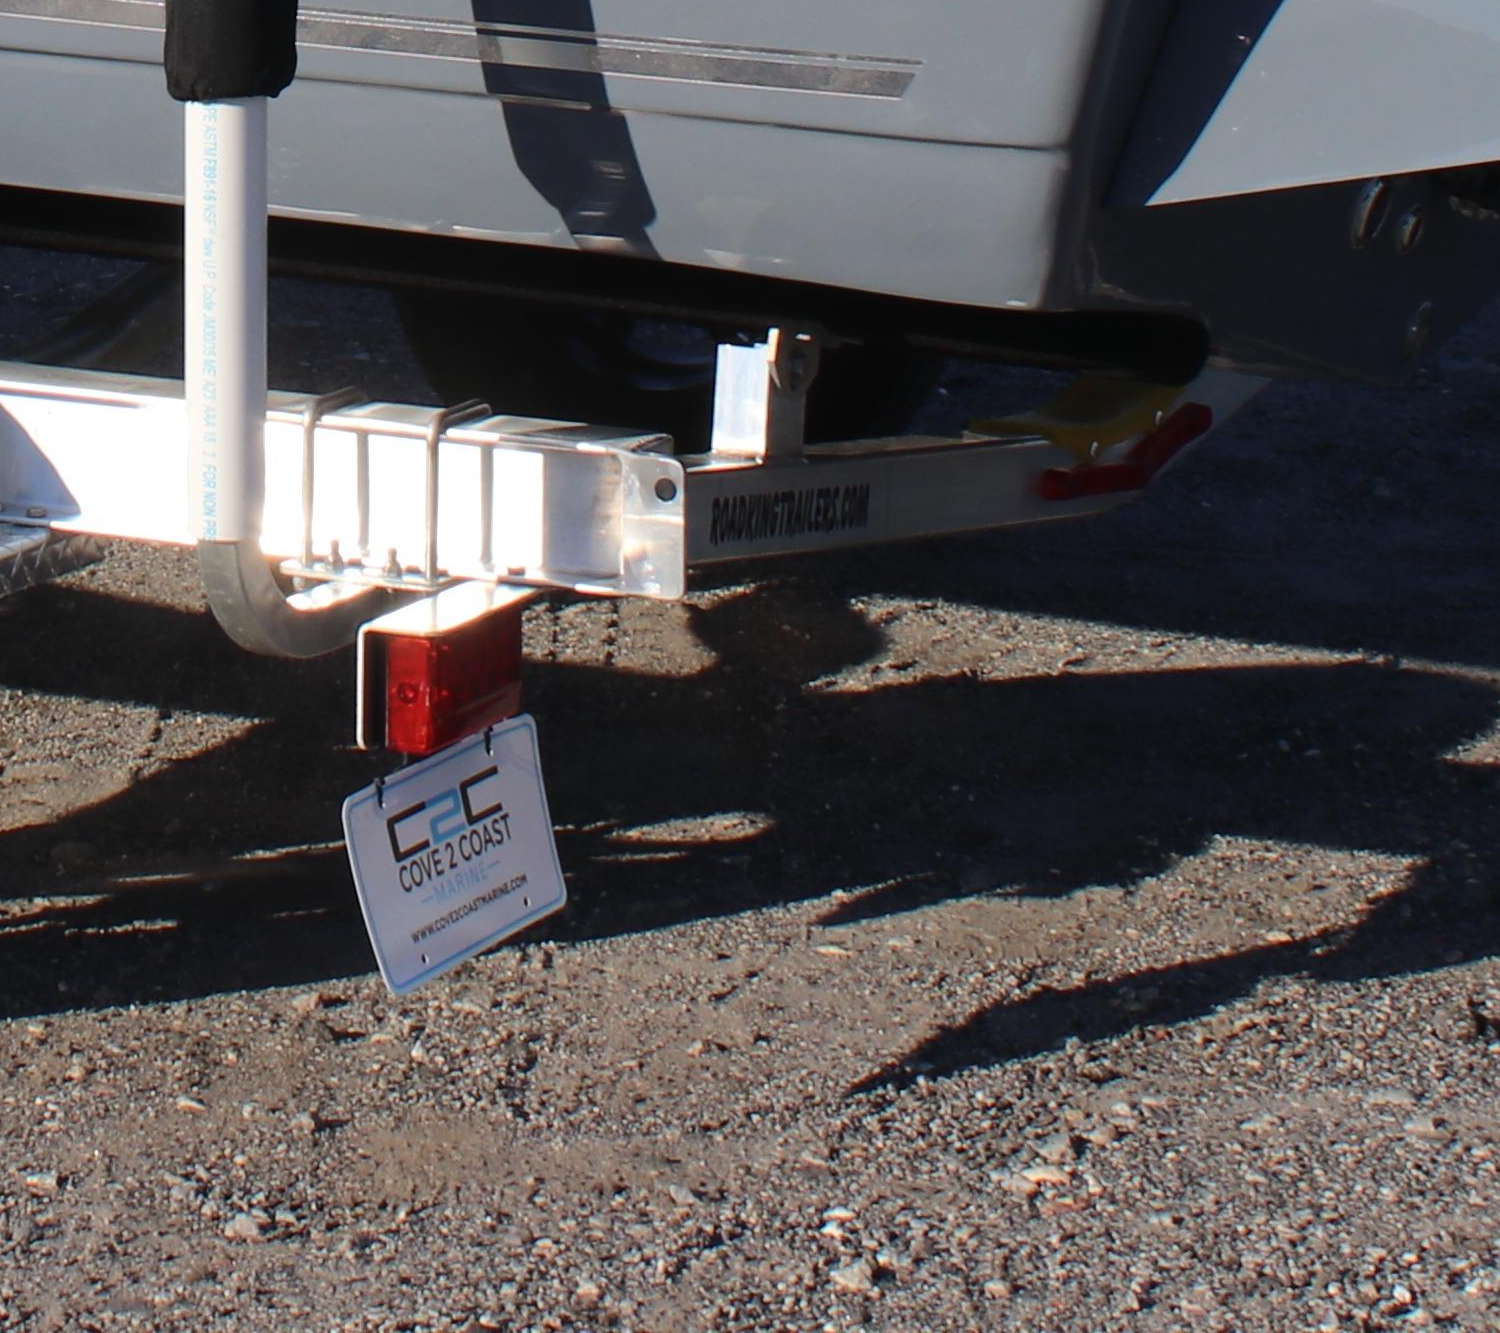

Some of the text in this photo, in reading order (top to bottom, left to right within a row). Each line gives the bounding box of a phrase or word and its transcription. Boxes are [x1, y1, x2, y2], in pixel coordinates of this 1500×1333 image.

[203, 492, 217, 518] NON
[387, 765, 503, 863] C2C
[398, 812, 513, 893] COVE 2 COAST
[433, 867, 489, 904] MARINE
